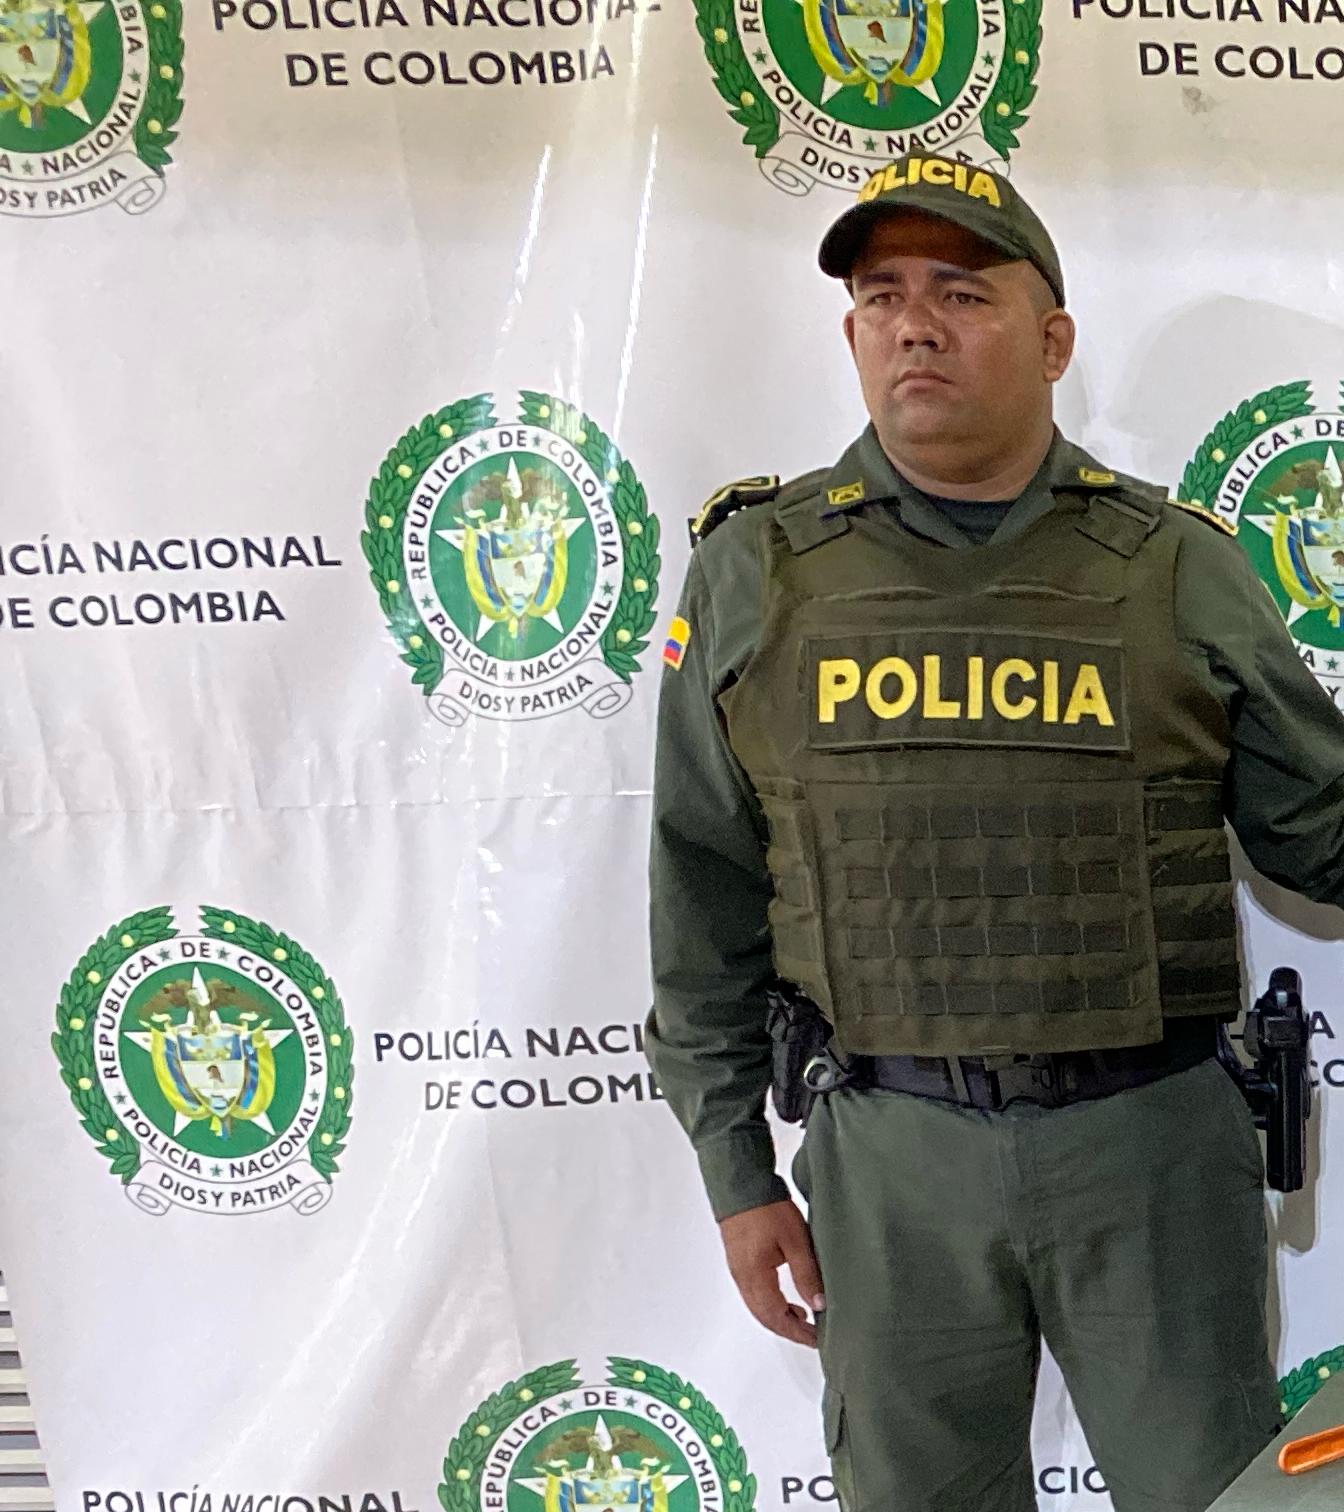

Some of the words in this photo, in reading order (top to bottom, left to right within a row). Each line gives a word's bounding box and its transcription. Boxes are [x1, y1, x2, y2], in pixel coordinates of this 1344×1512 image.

[423, 0, 662, 28] NACIONA
[285, 52, 349, 87] DE
[363, 45, 616, 86] COLOMBIA
[1138, 42, 1200, 76] DE
[41, 88, 141, 175] NACIONAL
[887, 70, 993, 154] NACIONAL
[46, 168, 127, 209] PATRIA
[857, 158, 1001, 208] OLICIA
[499, 430, 527, 448] DE
[547, 440, 618, 567] COLOMBIA
[0, 534, 85, 576] ICÍA
[93, 535, 342, 573] NACIONAL
[0, 597, 34, 628] E
[50, 590, 286, 627] COLOMBIA
[520, 599, 612, 681] NACIONAL
[520, 673, 593, 713] PATRIA
[818, 654, 1115, 726] POLICIA
[180, 942, 211, 958] DE
[237, 955, 322, 1076] COLOMBIA
[374, 1020, 512, 1062] POLICÍA
[526, 1023, 644, 1058] NACI
[424, 1080, 463, 1111] DE
[471, 1072, 666, 1109] COLOM
[229, 1105, 318, 1178] NACIONAL
[231, 1172, 302, 1207] PATRIA
[584, 1391, 618, 1406] DE
